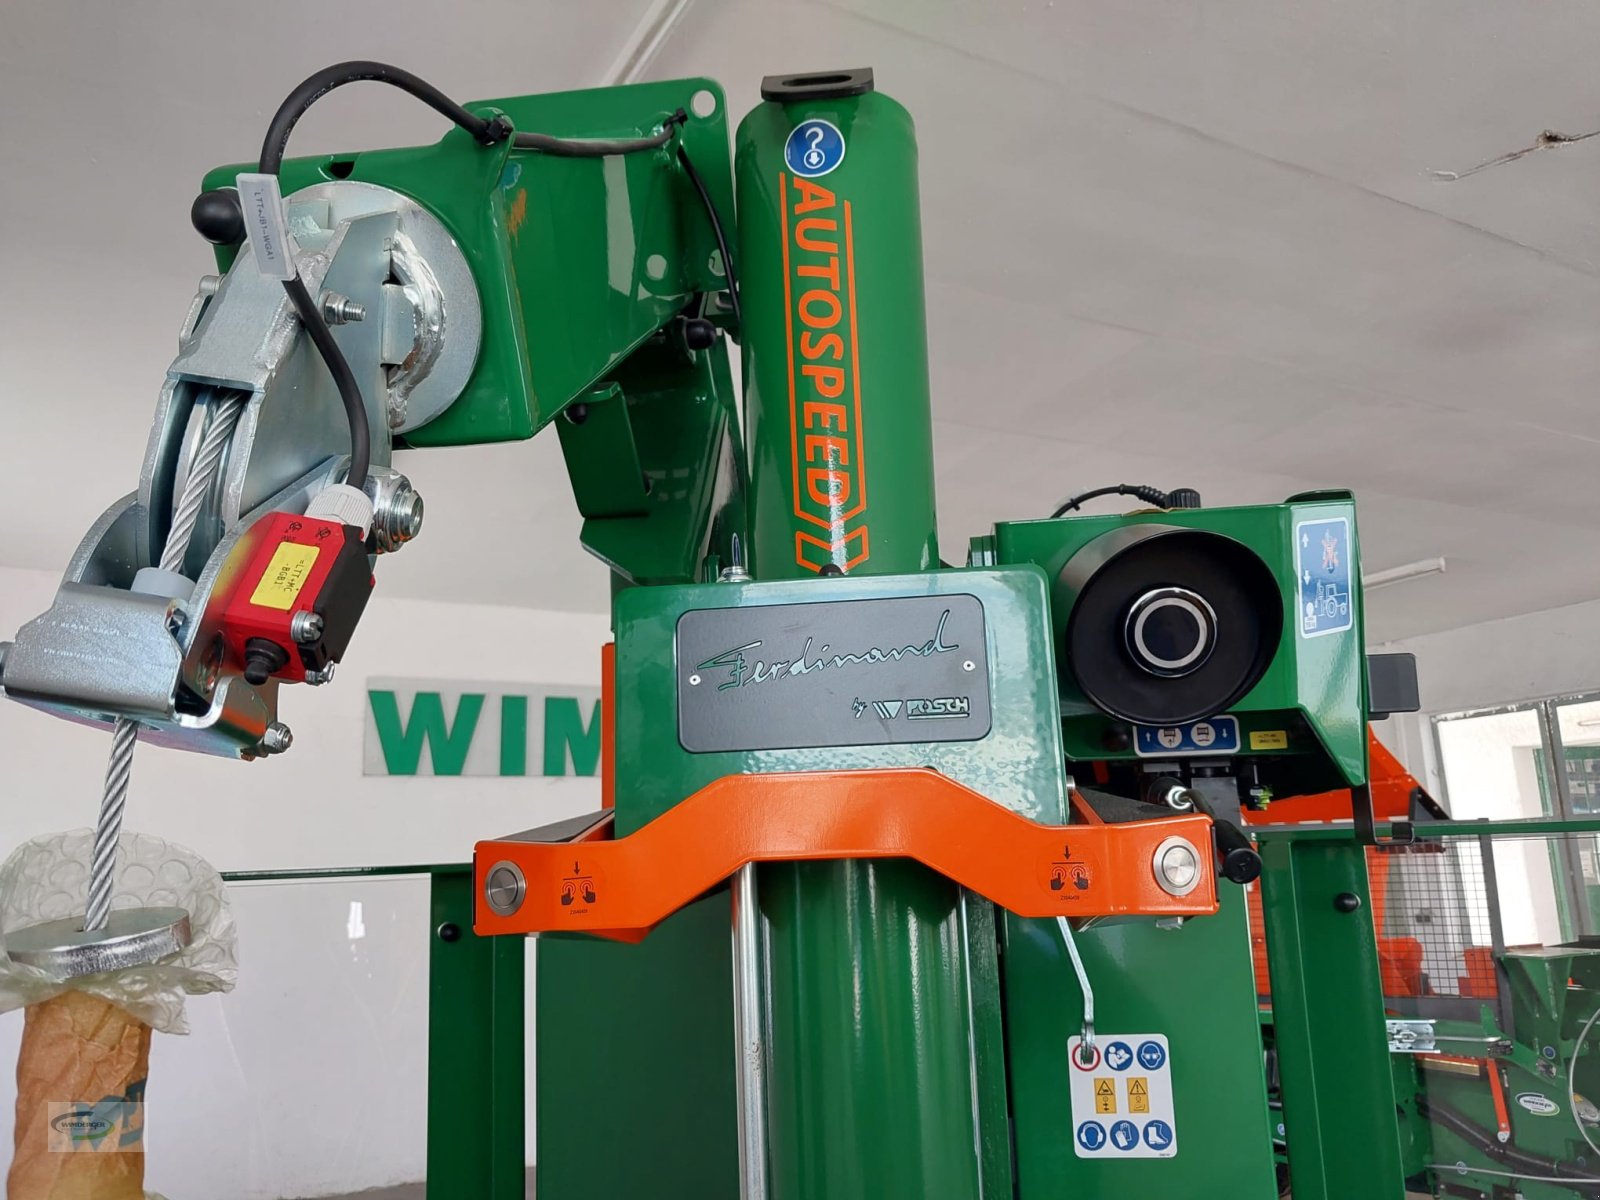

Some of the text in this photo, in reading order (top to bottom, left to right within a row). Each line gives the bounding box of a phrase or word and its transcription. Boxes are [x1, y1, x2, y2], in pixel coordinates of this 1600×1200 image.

[792, 178, 851, 507] AUTOSPEED
[697, 608, 960, 691] Ferdinand
[851, 696, 869, 720] by
